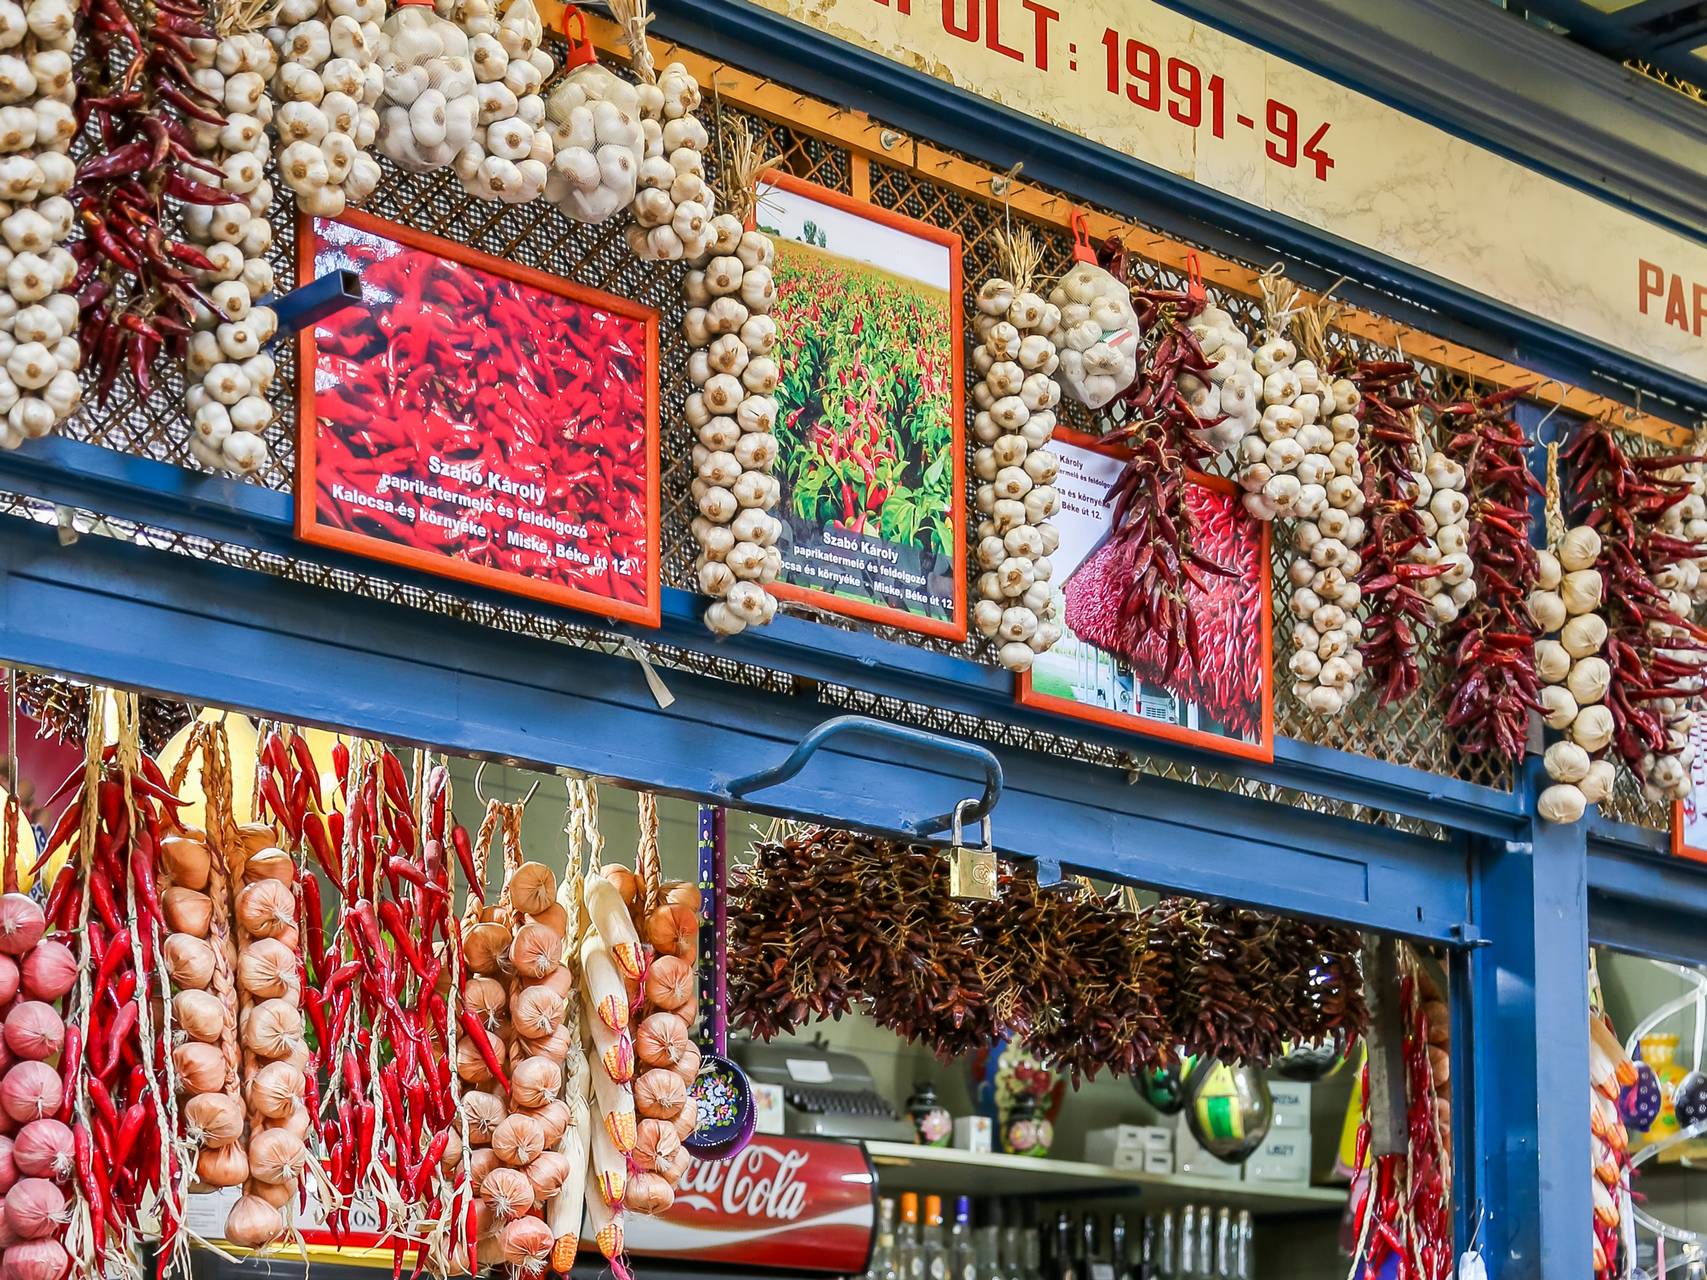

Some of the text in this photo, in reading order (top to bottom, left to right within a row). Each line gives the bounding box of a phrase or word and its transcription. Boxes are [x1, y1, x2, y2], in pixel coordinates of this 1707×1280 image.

[1101, 27, 1336, 182] 1991-94
[428, 455, 547, 506] Szabó Károly
[1059, 454, 1084, 471] Károly
[332, 484, 394, 514] Kalocsa
[397, 502, 416, 521] és
[419, 507, 487, 539] környéke
[507, 530, 552, 557] Miske,
[555, 544, 590, 566] Béke
[381, 473, 588, 540] paprikatermelő és feldolgozó
[1061, 501, 1102, 520] Béke út 12.
[793, 544, 926, 586] paprikatermelő és feldolgozó
[823, 531, 899, 564] Szabó Károly
[780, 560, 802, 573] ocsa
[804, 565, 816, 577] és
[817, 566, 861, 587] környéke
[873, 580, 903, 599] Miske,
[905, 590, 928, 604] Béke
